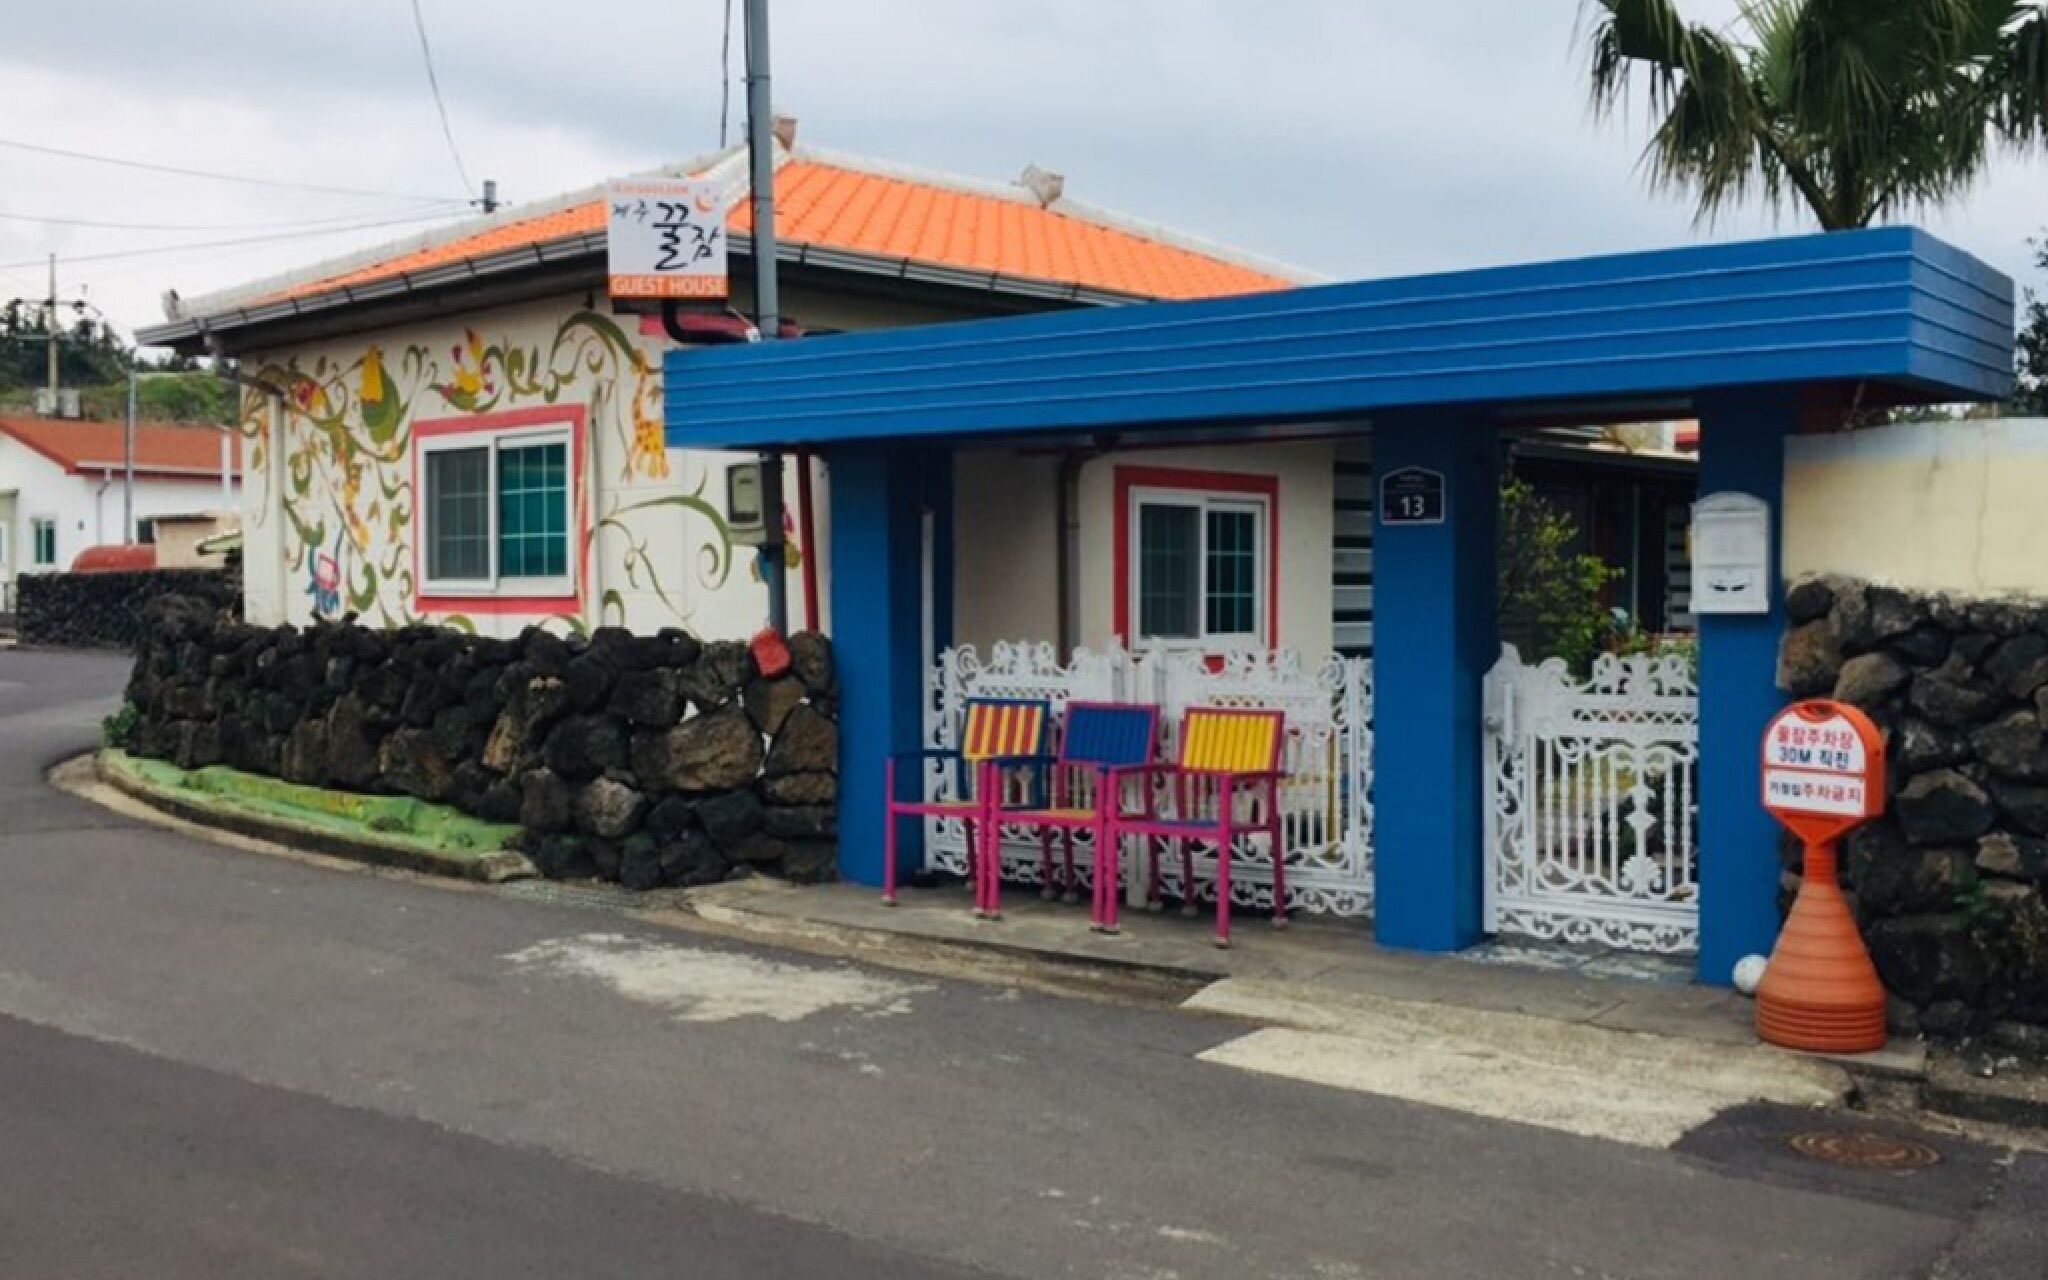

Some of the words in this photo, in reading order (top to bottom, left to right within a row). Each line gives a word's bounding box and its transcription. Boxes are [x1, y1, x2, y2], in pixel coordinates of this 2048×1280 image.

[652, 201, 721, 272] 꿀잠
[613, 277, 664, 295] GUEST
[671, 276, 726, 295] HOUSE
[1401, 495, 1425, 517] 13
[1779, 746, 1811, 763] 30M
